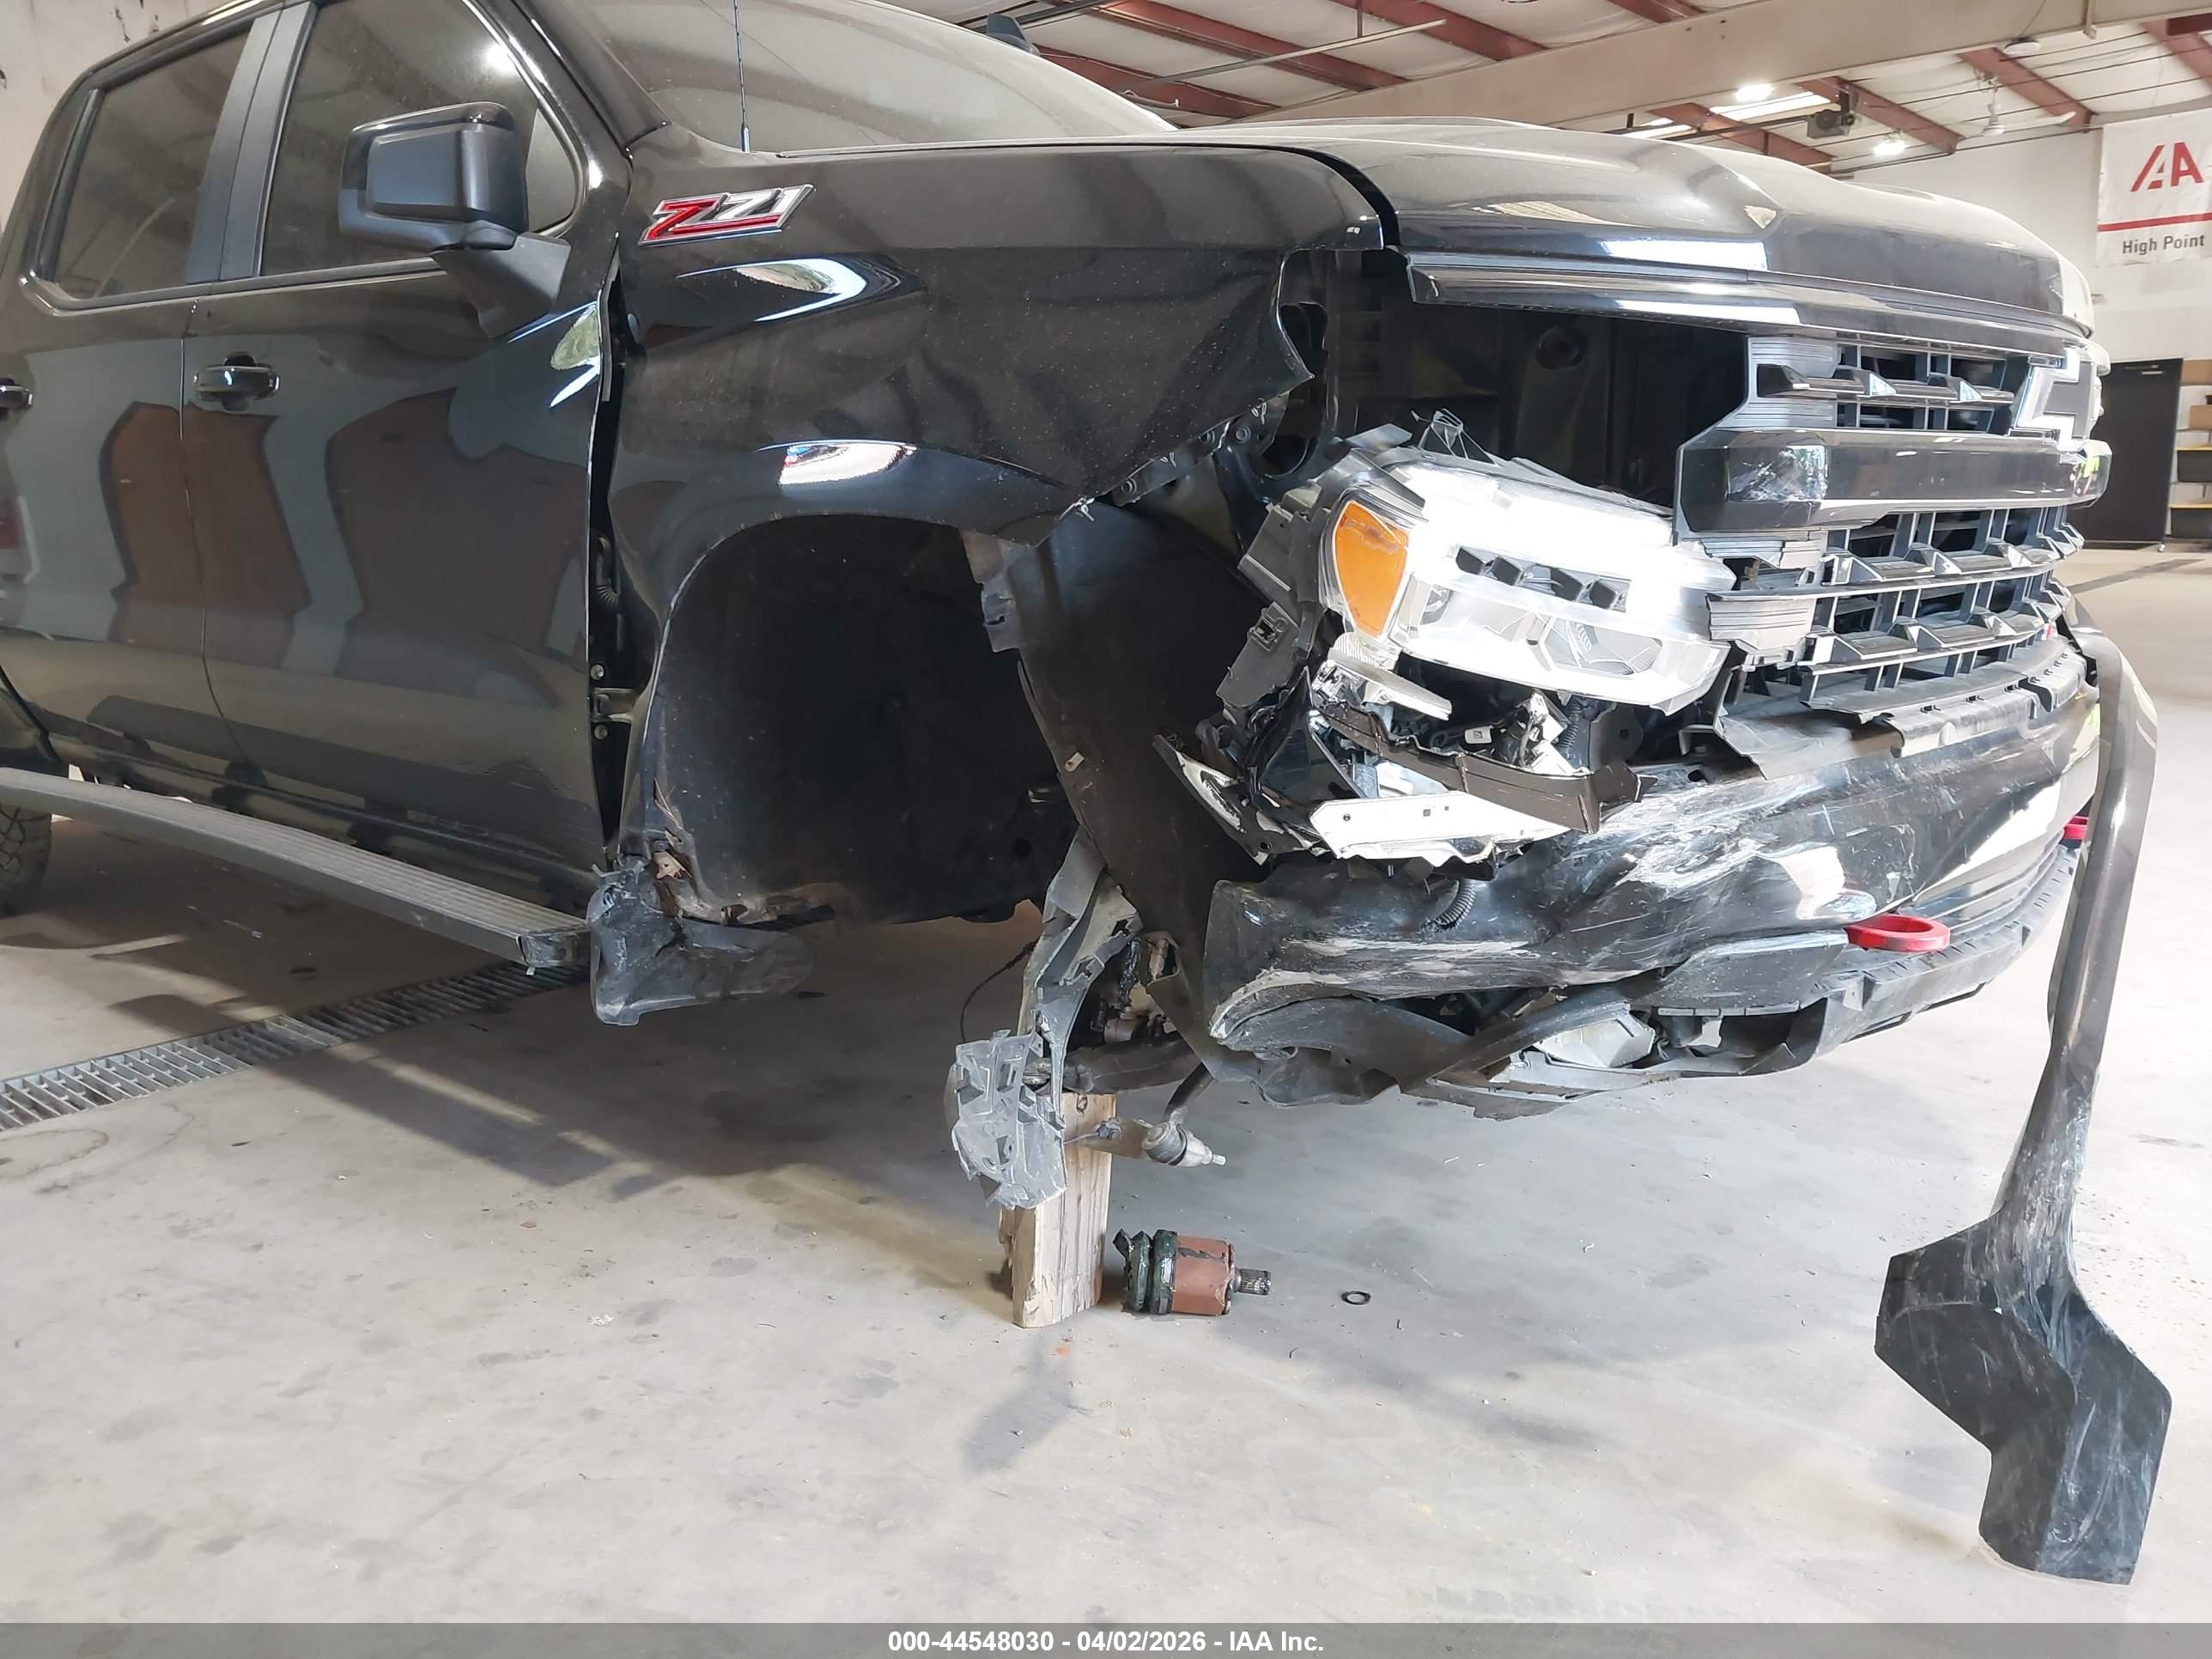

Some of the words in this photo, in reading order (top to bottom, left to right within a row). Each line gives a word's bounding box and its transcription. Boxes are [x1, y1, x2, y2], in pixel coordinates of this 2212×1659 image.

[638, 184, 814, 247] Z71
[2122, 238, 2158, 256] High
[2163, 234, 2206, 250] Point
